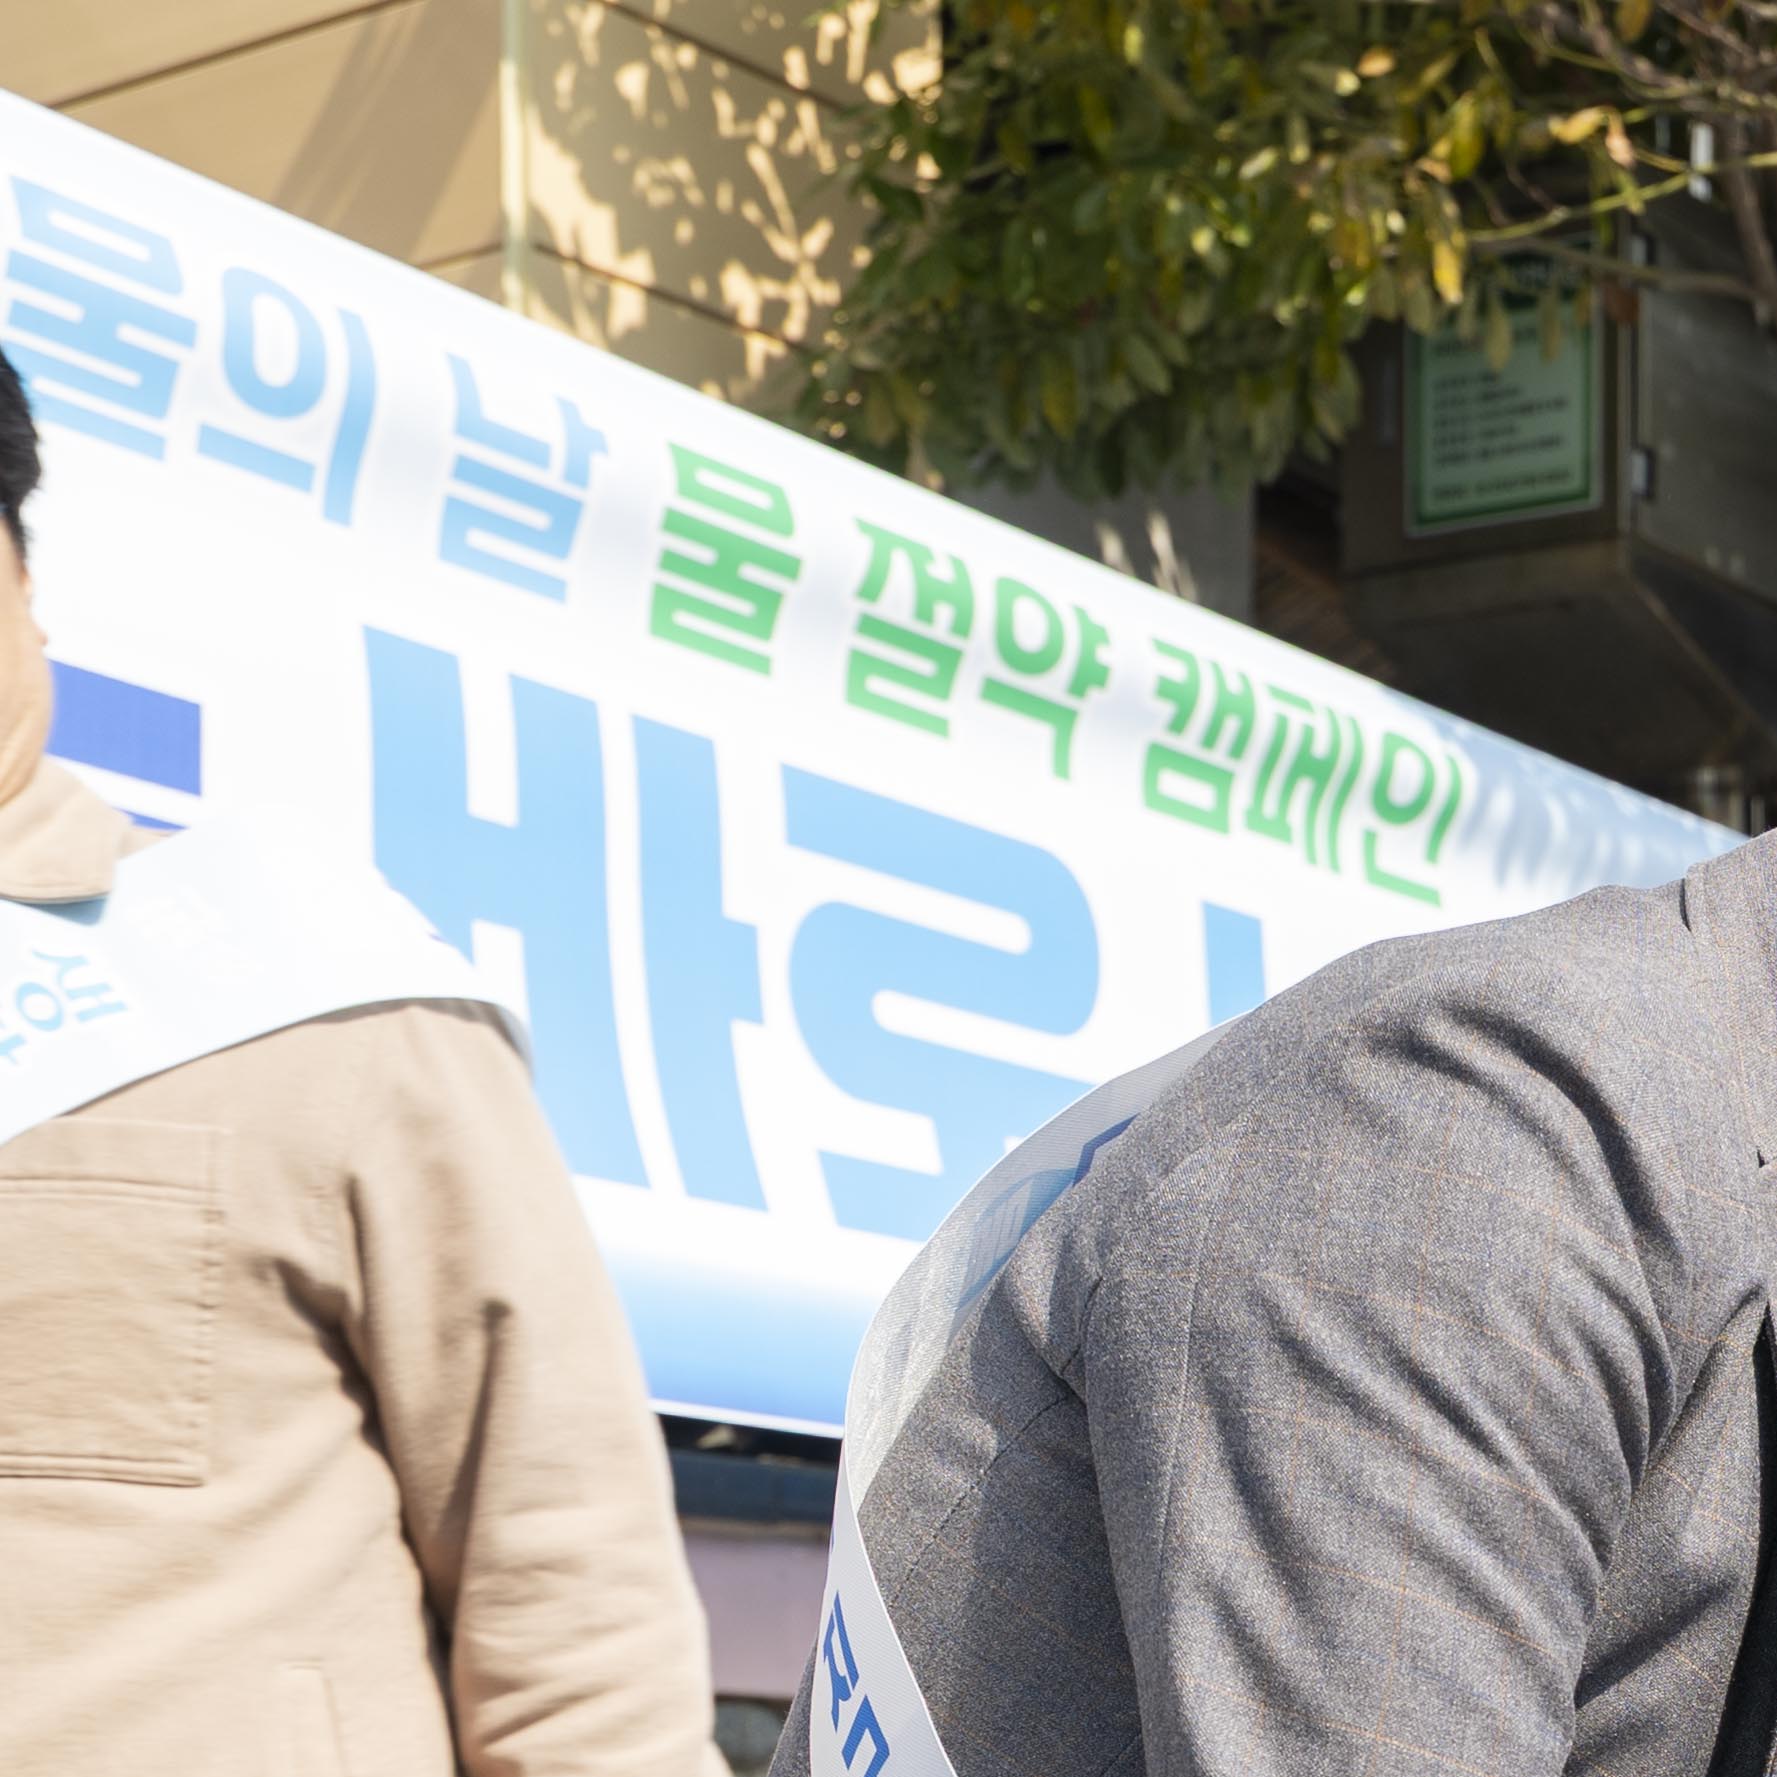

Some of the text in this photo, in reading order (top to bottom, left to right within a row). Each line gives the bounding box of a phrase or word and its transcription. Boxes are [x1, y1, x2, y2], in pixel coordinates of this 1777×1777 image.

[3, 175, 1464, 908] 물의 날 물 절약 캠페인
